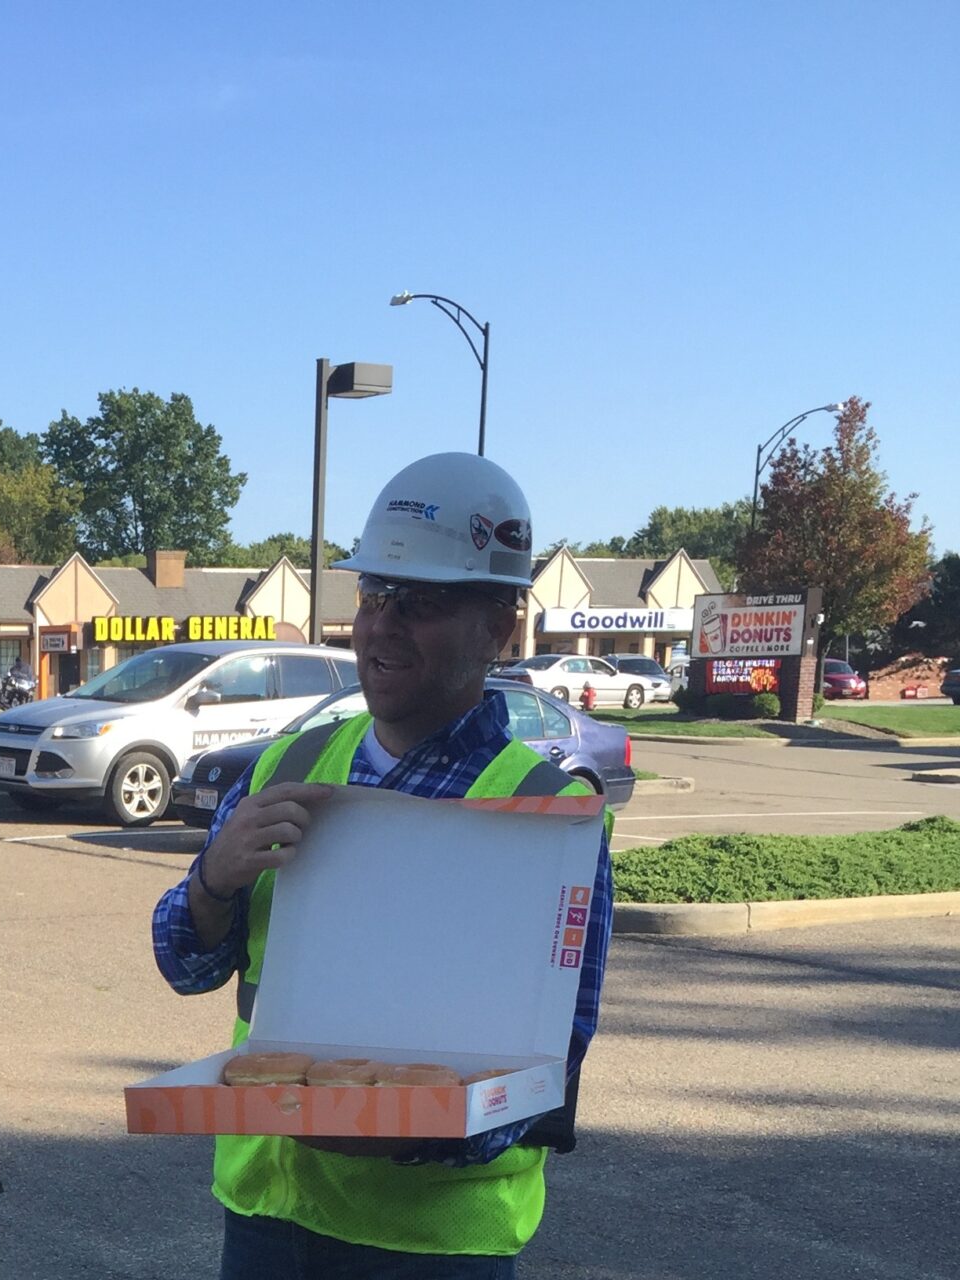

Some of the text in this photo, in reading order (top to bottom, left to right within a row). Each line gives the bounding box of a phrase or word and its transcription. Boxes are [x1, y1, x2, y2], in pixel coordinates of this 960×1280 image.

[389, 500, 426, 509] HAMMOND
[746, 594, 801, 605] DRIVE THRU
[570, 611, 664, 629] Goodwill
[731, 610, 797, 628] DUNKIN'
[94, 615, 277, 641] DOLLAR GENERAL
[730, 627, 792, 643] DONUTS
[767, 644, 790, 652] MORE
